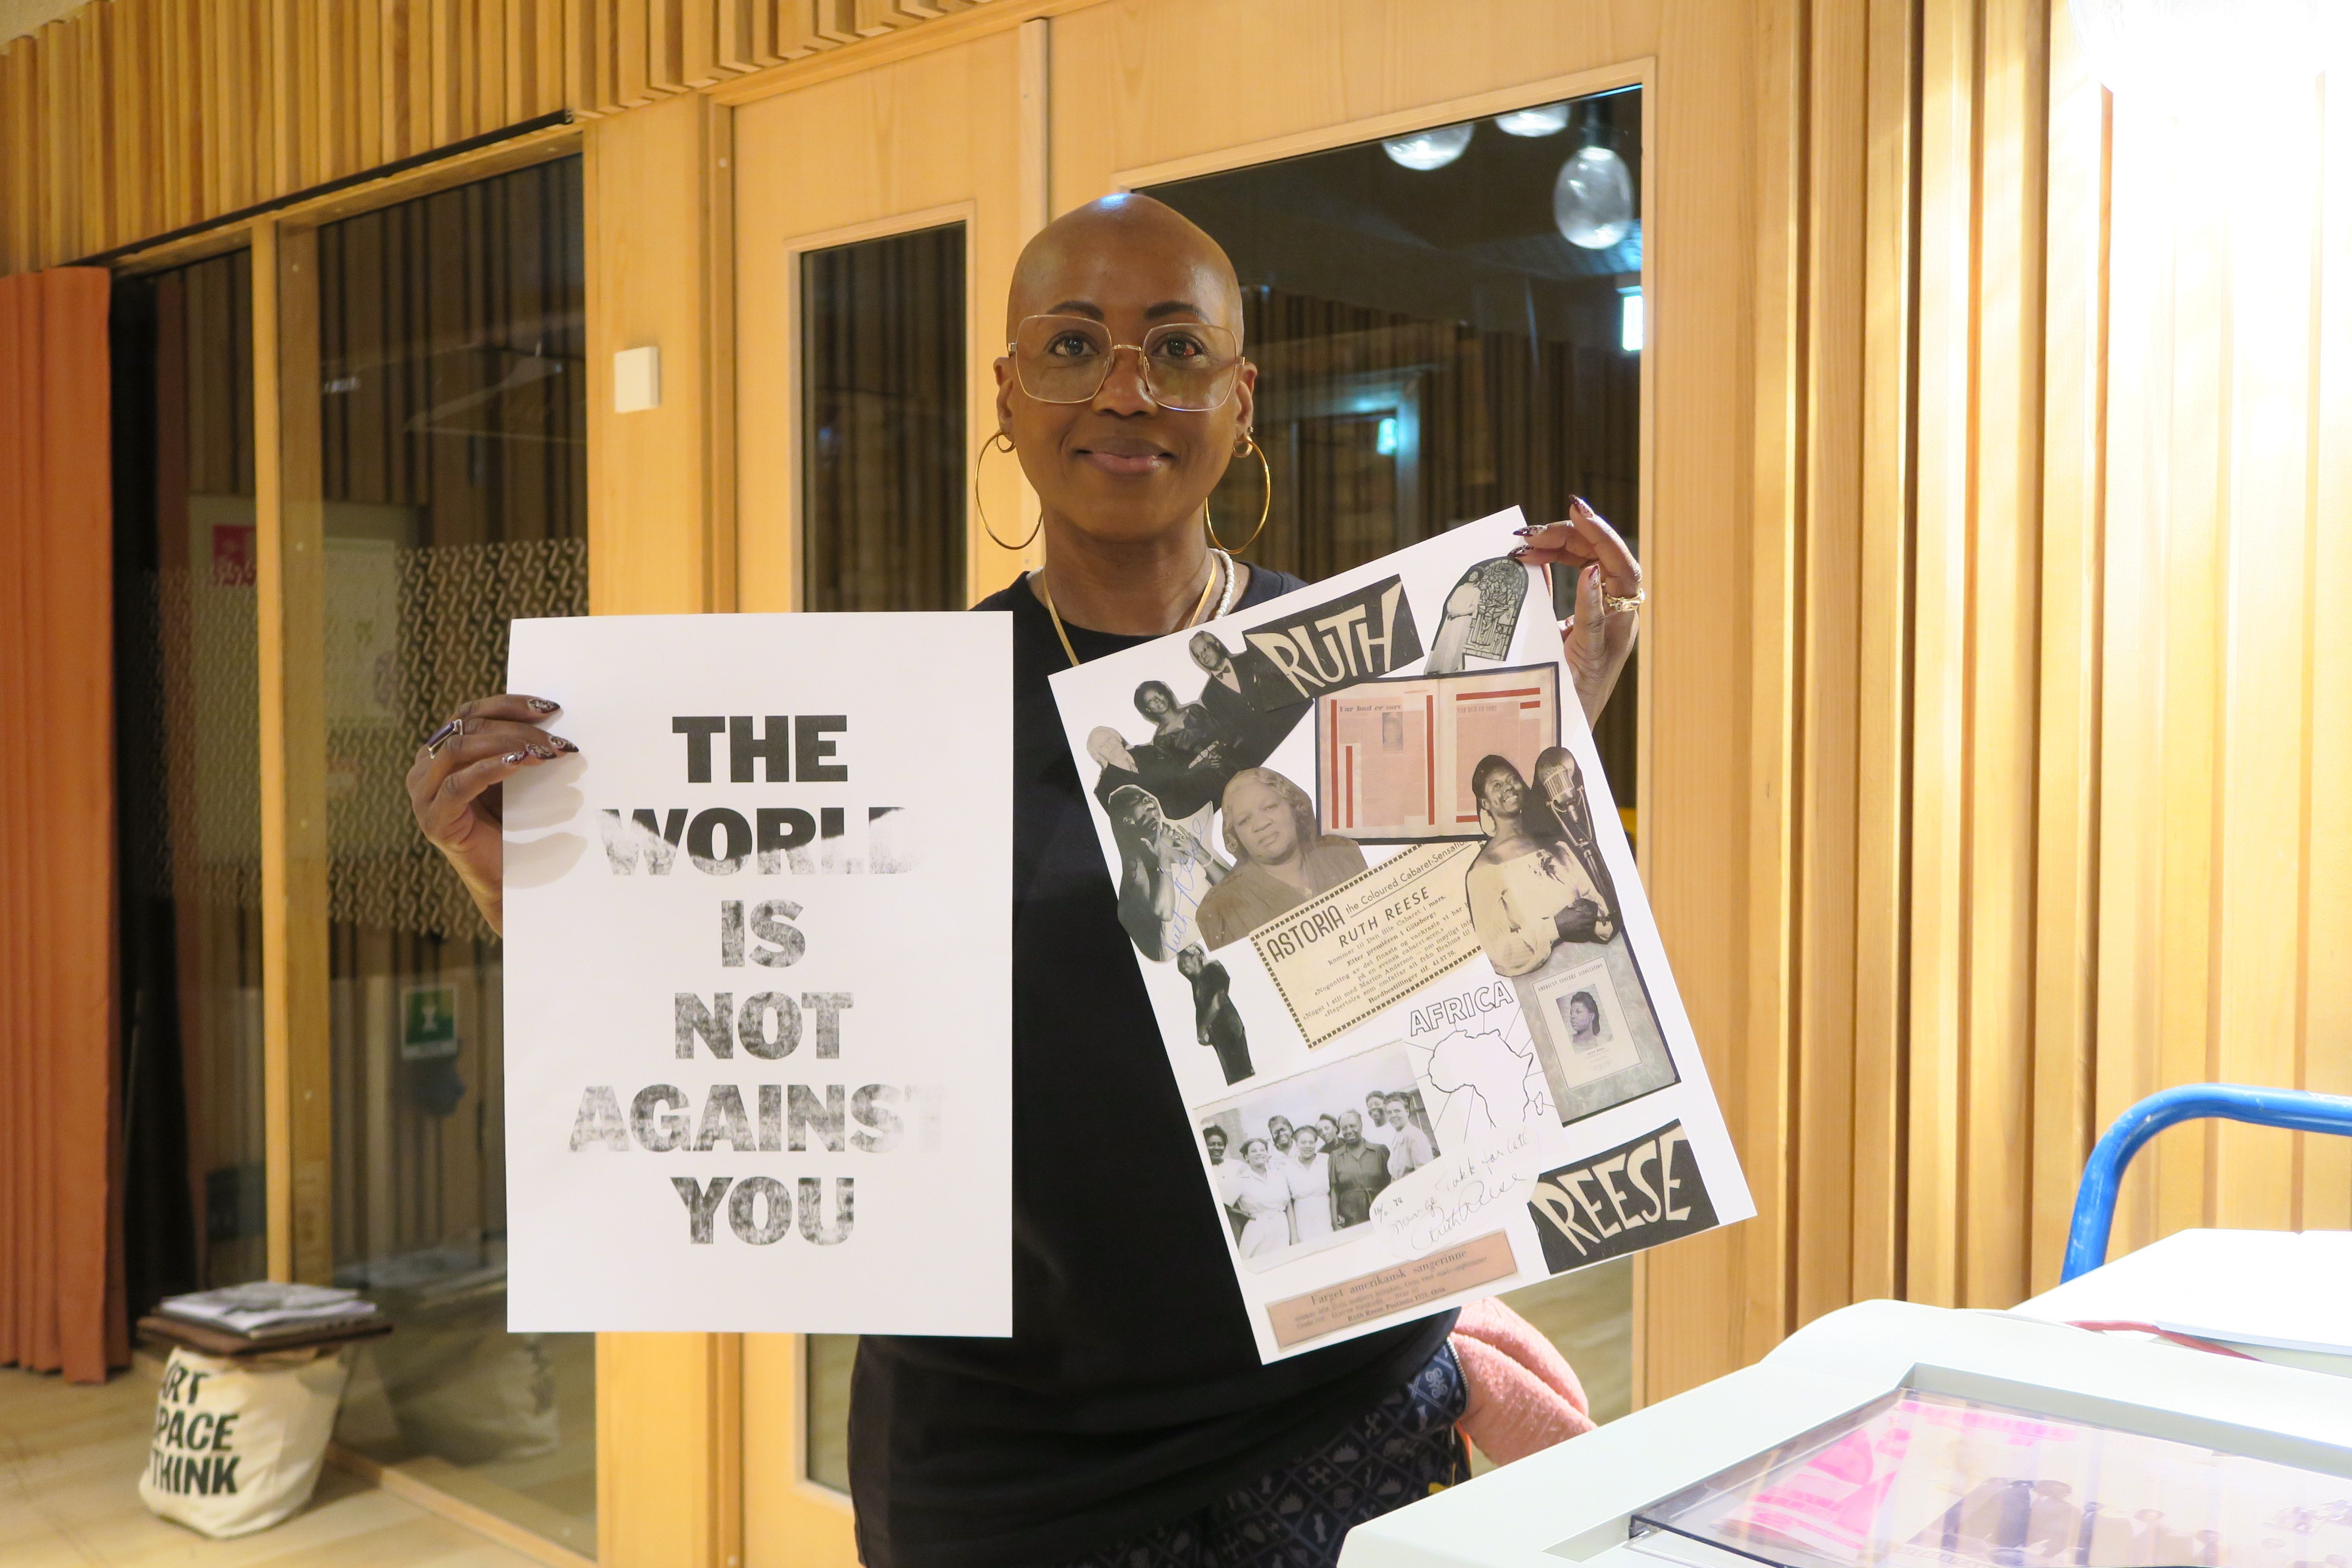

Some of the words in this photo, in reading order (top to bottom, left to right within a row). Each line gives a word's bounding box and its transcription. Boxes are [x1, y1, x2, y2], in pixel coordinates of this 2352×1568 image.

[1245, 581, 1402, 698] RUTH
[672, 715, 848, 784] THE
[1267, 905, 1345, 963] ASTORIA
[1345, 903, 1359, 914] the
[1361, 877, 1399, 904] Coloured
[1400, 841, 1467, 882] Cabaret-Sensatio
[1327, 949, 1354, 966] kommer
[1366, 934, 1380, 944] Den
[1381, 926, 1394, 935] lille
[1396, 910, 1421, 926] Cabaret
[1428, 896, 1446, 907] mars.
[1338, 916, 1378, 948] RUTH
[1385, 886, 1429, 921] REESE
[720, 899, 806, 969] IS
[1347, 955, 1363, 966] Etter
[1363, 960, 1373, 968] det
[1376, 946, 1398, 961] finaste
[1410, 921, 1440, 940] vackraste
[1451, 907, 1462, 916] har
[1344, 986, 1358, 997] med
[1359, 974, 1382, 989] Marion
[1385, 956, 1414, 975] Anderson
[1357, 973, 1366, 982] på
[1378, 954, 1400, 969] svensk
[1363, 986, 1376, 995] som
[1379, 969, 1406, 987] omfattar
[1409, 961, 1418, 969] alt
[1436, 936, 1461, 952] Brahms
[1368, 973, 1417, 1004] Bordbestillinger
[674, 990, 854, 1060] NOT
[1411, 980, 1514, 1037] AFRICA
[567, 1084, 948, 1153] AGAINST
[670, 1176, 854, 1246] YOU
[1530, 1126, 1691, 1256] REESE
[1350, 1268, 1406, 1294] amerikansk
[152, 1448, 241, 1495] THINK
